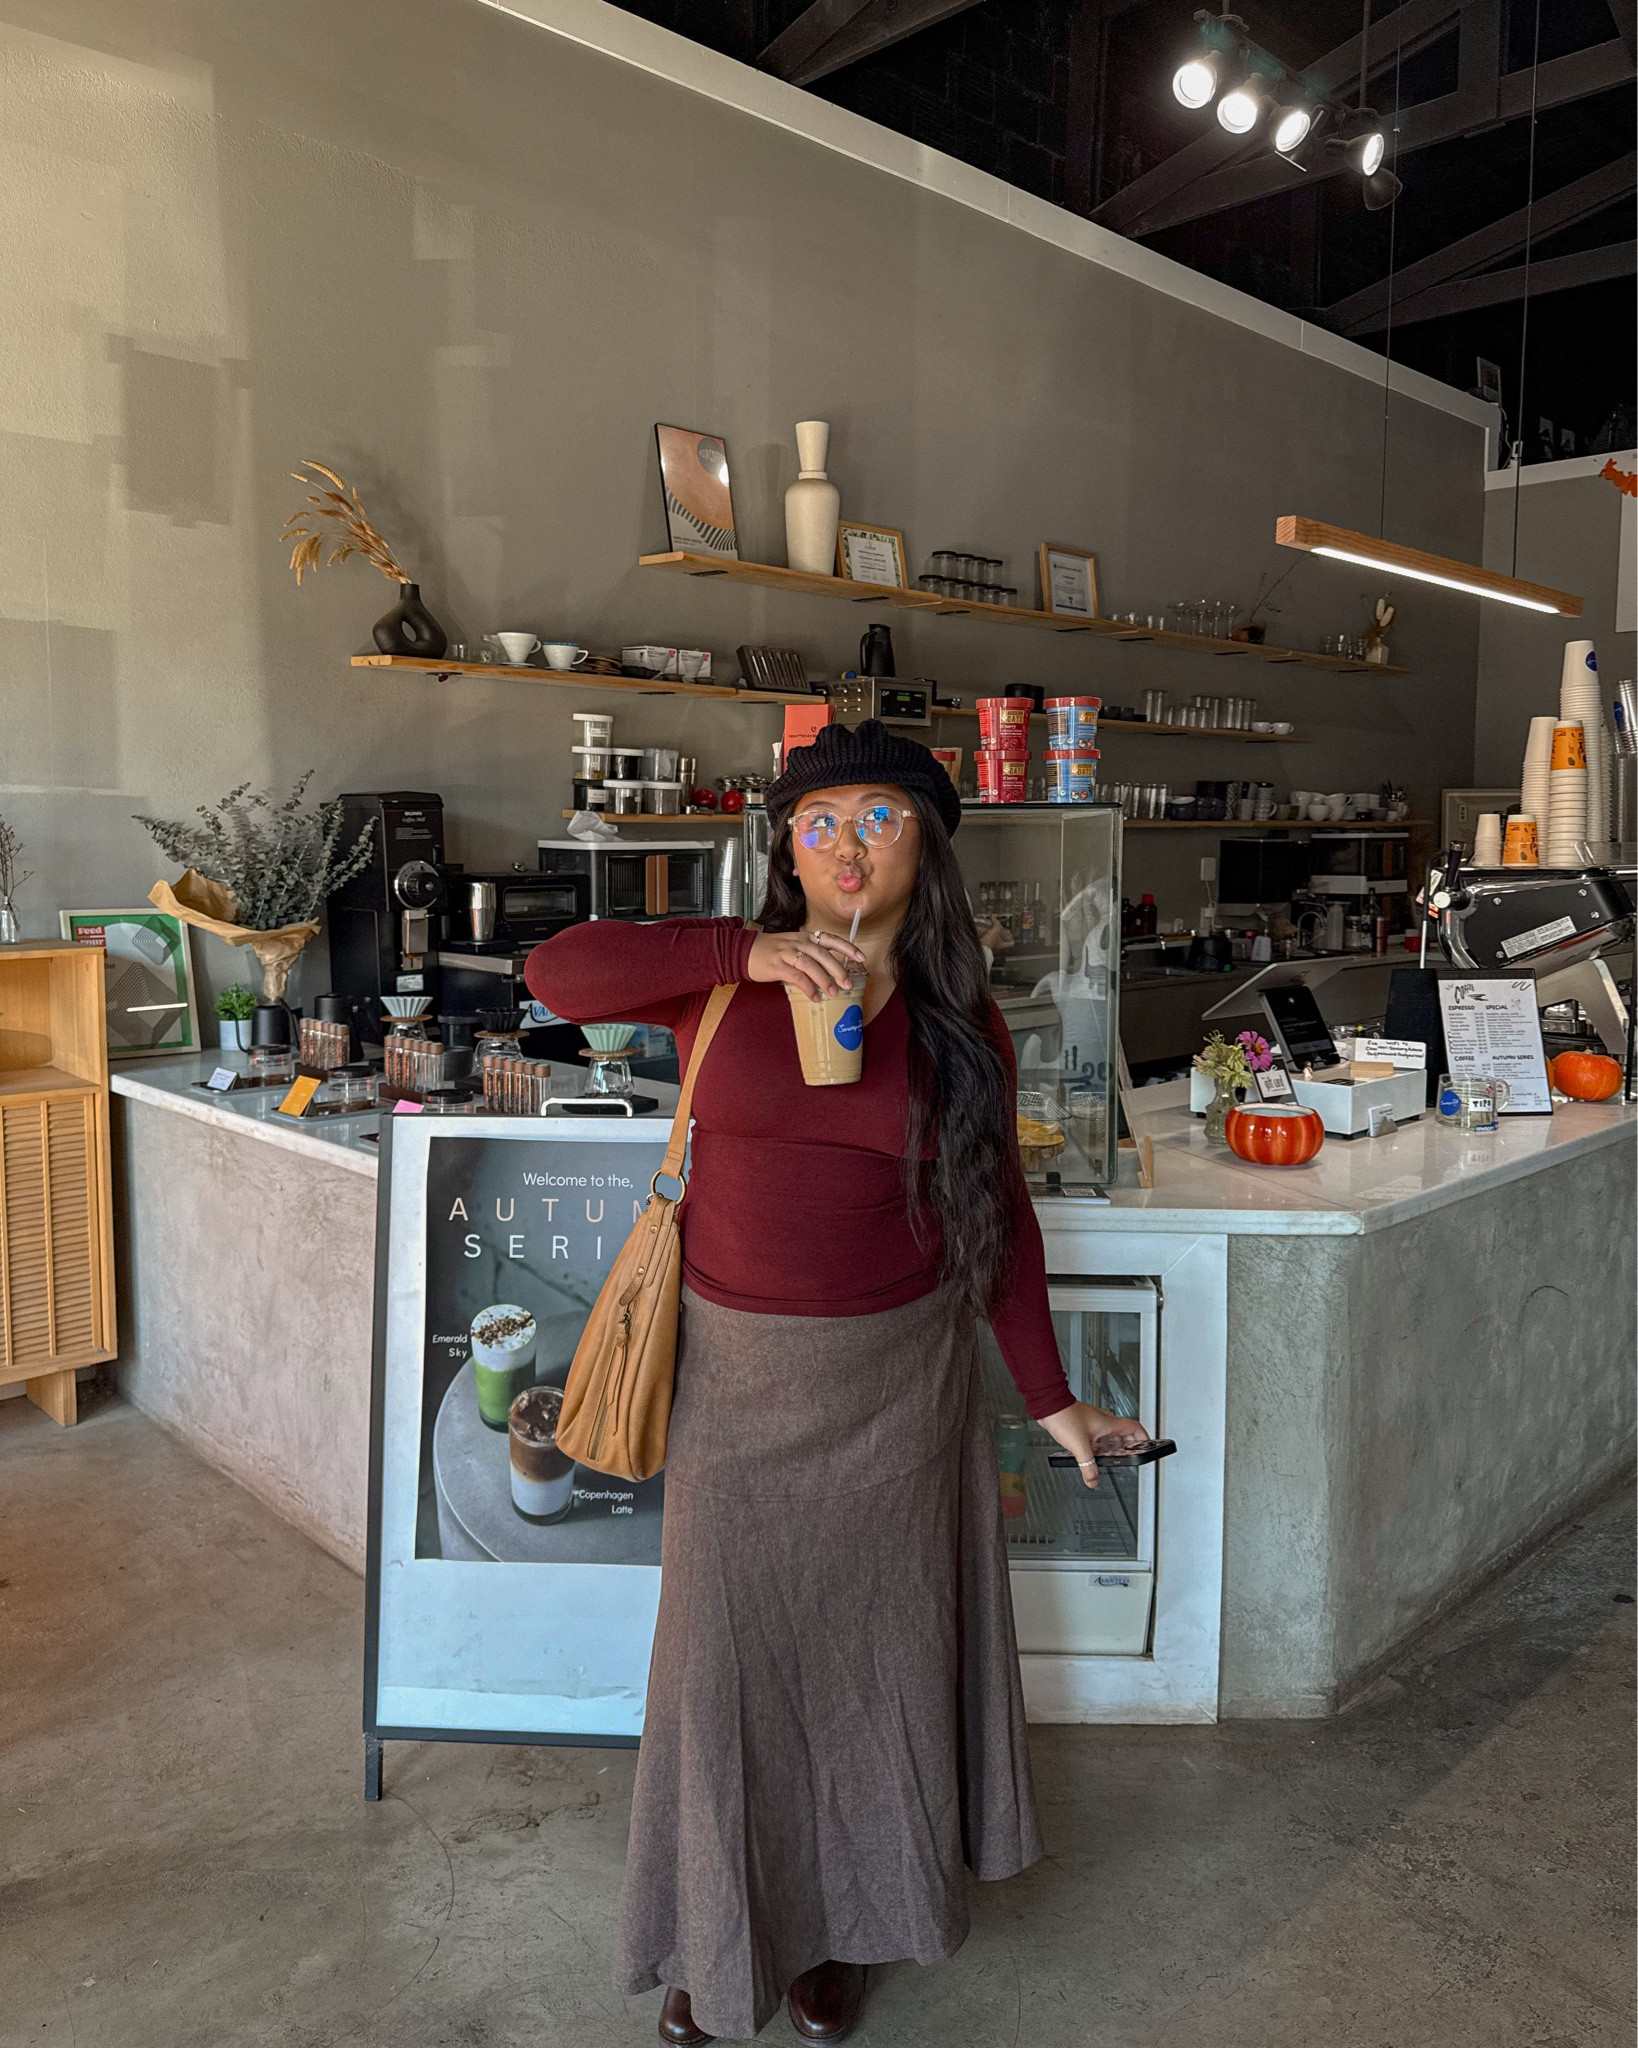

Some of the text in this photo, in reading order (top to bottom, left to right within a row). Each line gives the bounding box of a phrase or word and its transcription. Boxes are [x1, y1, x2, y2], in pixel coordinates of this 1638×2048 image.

[78, 927, 102, 935] Feed
[1472, 1100, 1491, 1108] TIPS
[523, 1173, 634, 1189] Welcome to the,
[448, 1197, 643, 1224] AUTU
[464, 1234, 601, 1260] SERI
[432, 1334, 468, 1343] Emerald
[449, 1348, 467, 1359] Sky
[579, 1490, 634, 1502] Copenhagen
[612, 1505, 634, 1514] Latte
